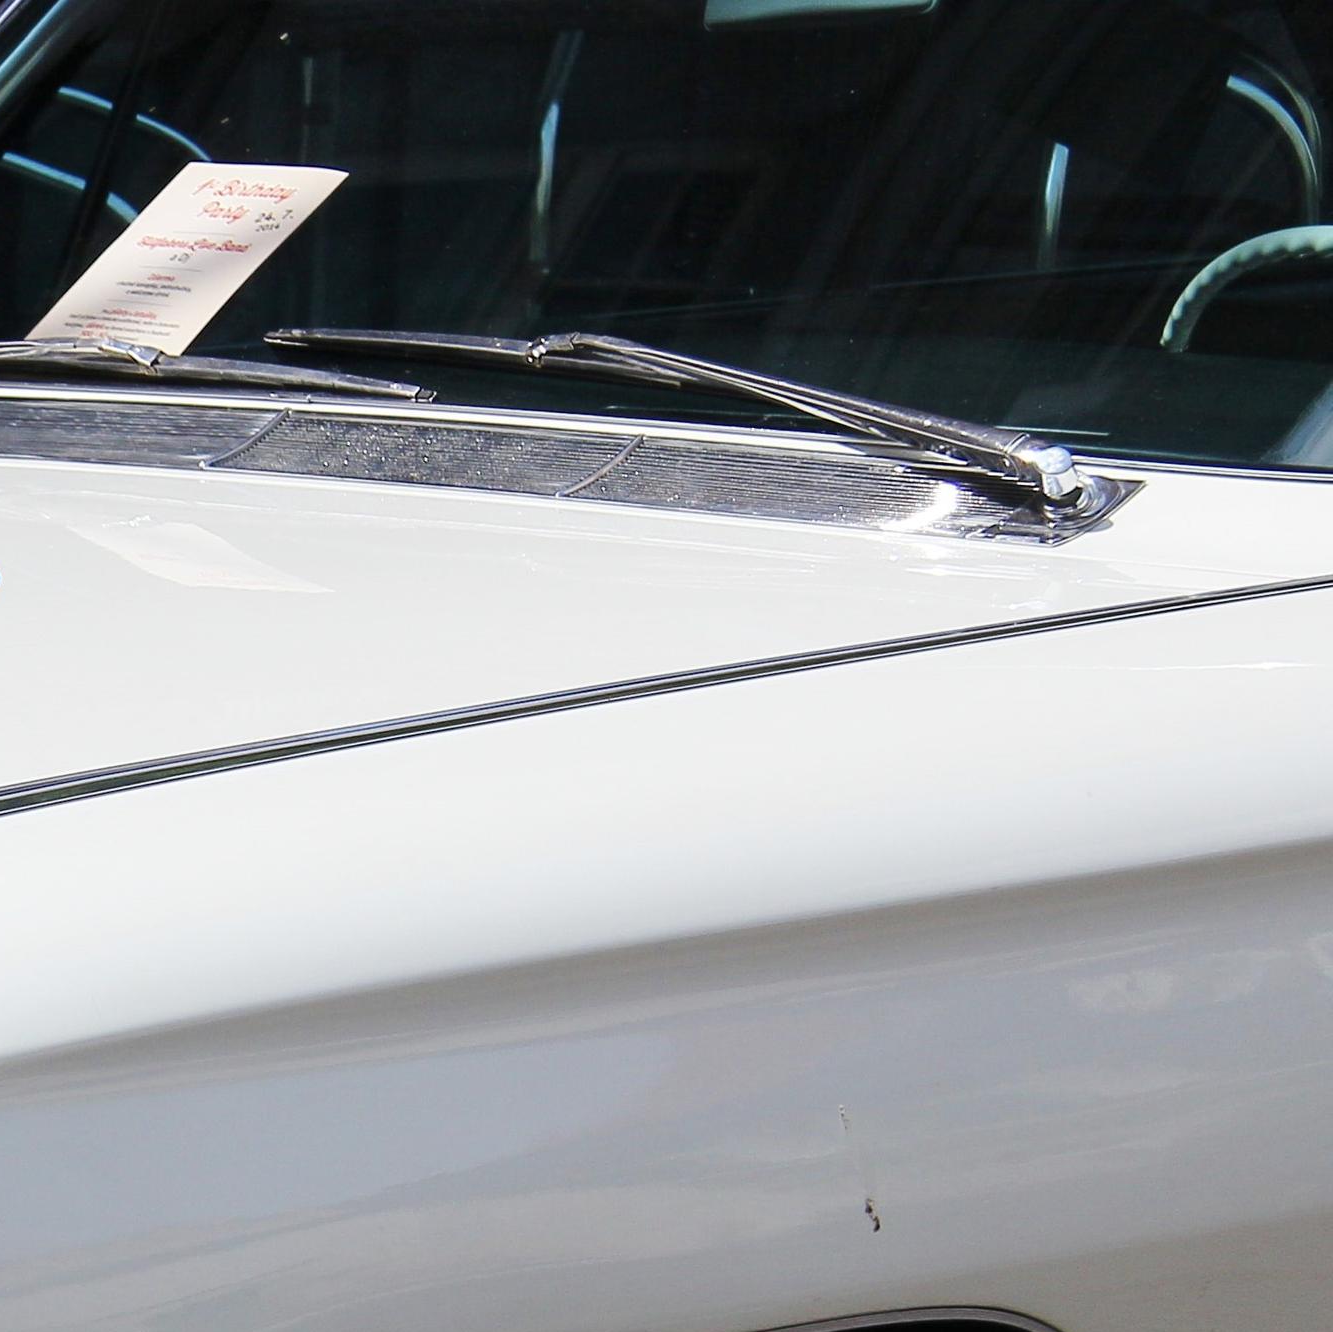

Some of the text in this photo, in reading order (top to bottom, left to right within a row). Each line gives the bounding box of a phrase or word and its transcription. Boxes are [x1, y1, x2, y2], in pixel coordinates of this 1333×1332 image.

[213, 179, 298, 205] Birthday
[197, 200, 250, 224] Party
[214, 239, 253, 253] Band
